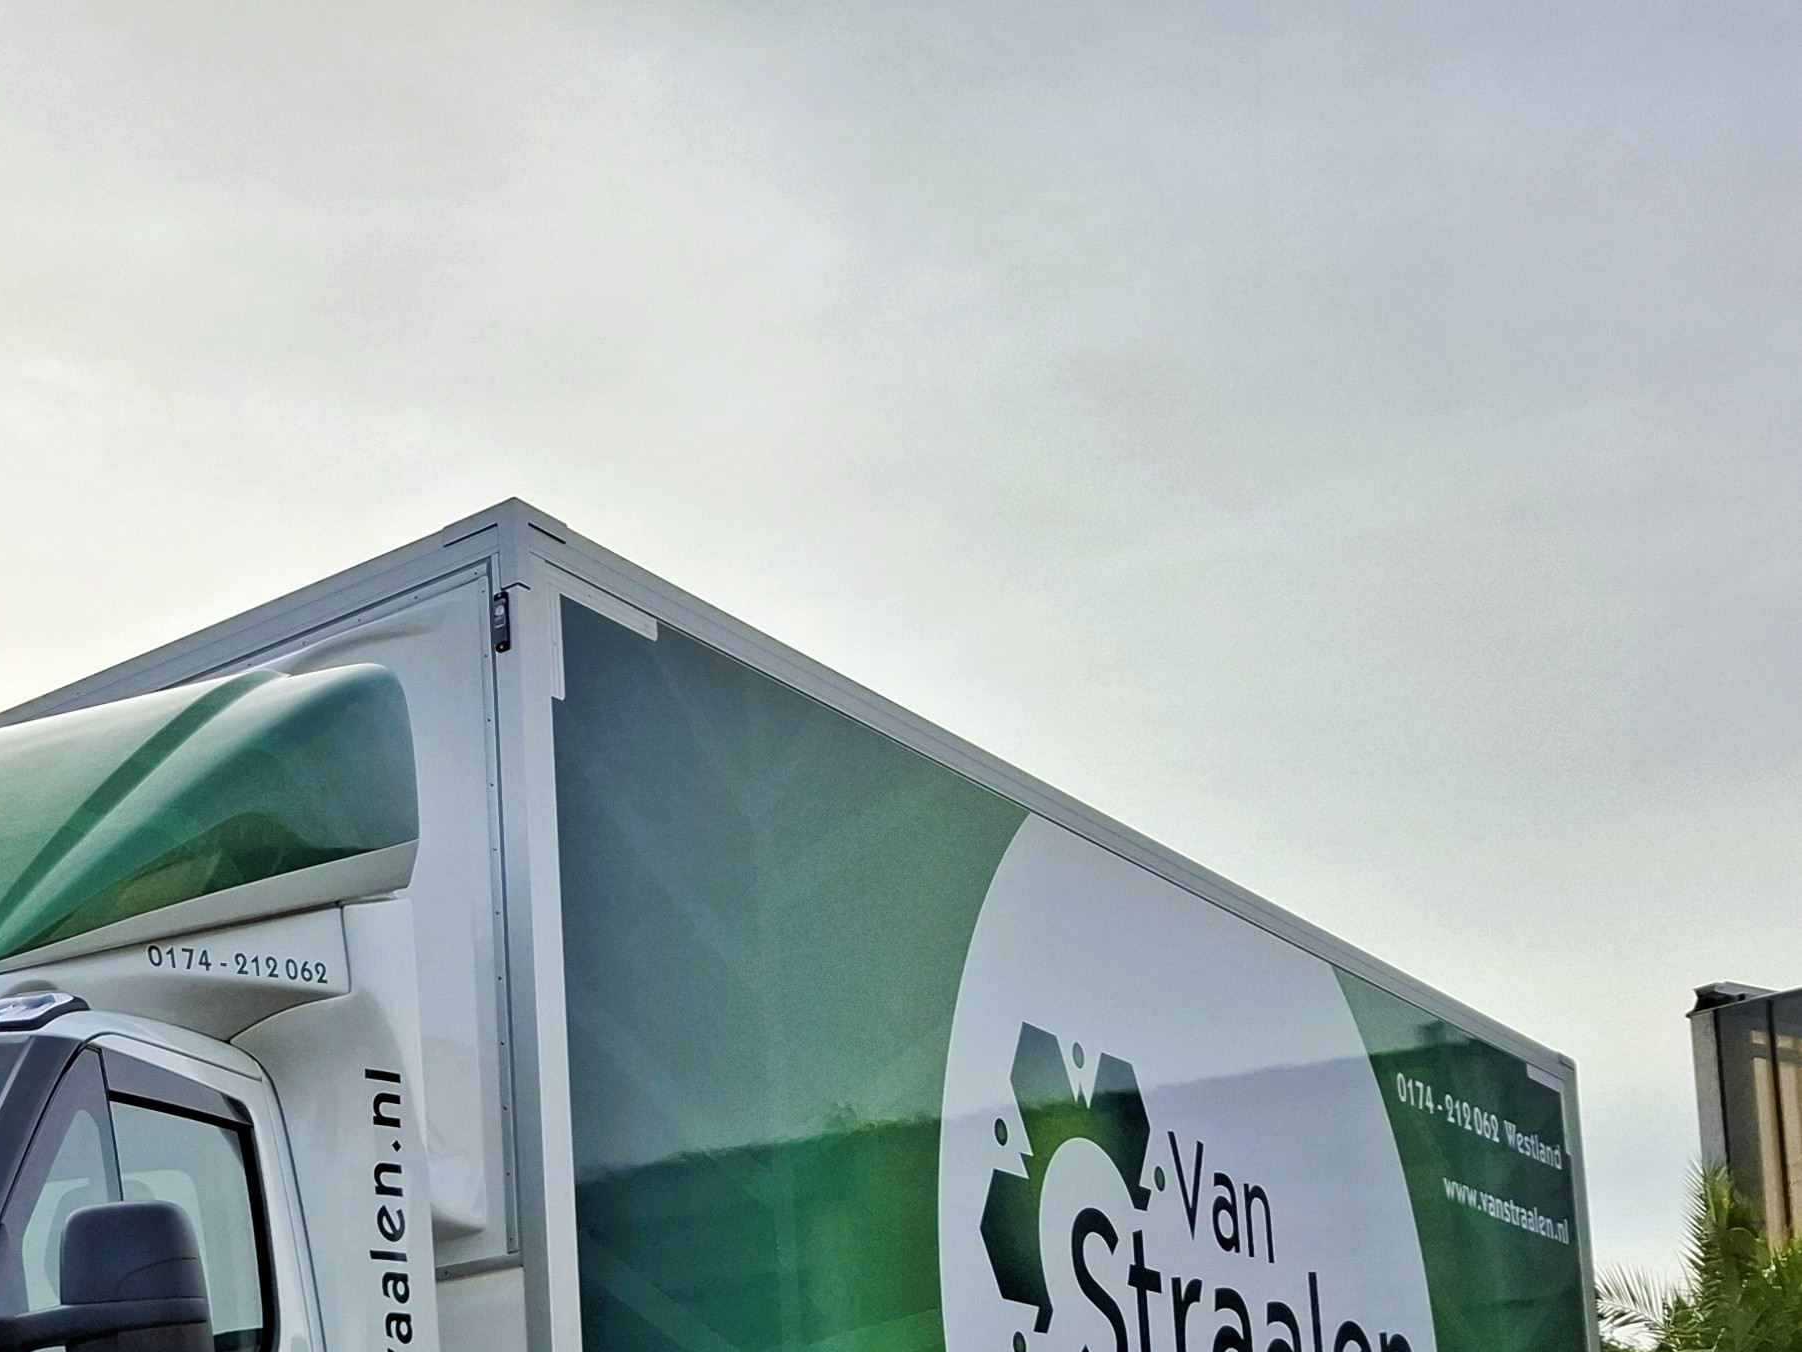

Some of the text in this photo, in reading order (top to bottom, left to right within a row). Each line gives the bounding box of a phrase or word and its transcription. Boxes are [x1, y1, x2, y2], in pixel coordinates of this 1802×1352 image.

[148, 945, 212, 971] 0174
[285, 958, 328, 984] 062
[1503, 1119, 1562, 1170] Westland
[1167, 1130, 1274, 1264] Van
[1443, 1177, 1569, 1244] www.vanstraalen.nl
